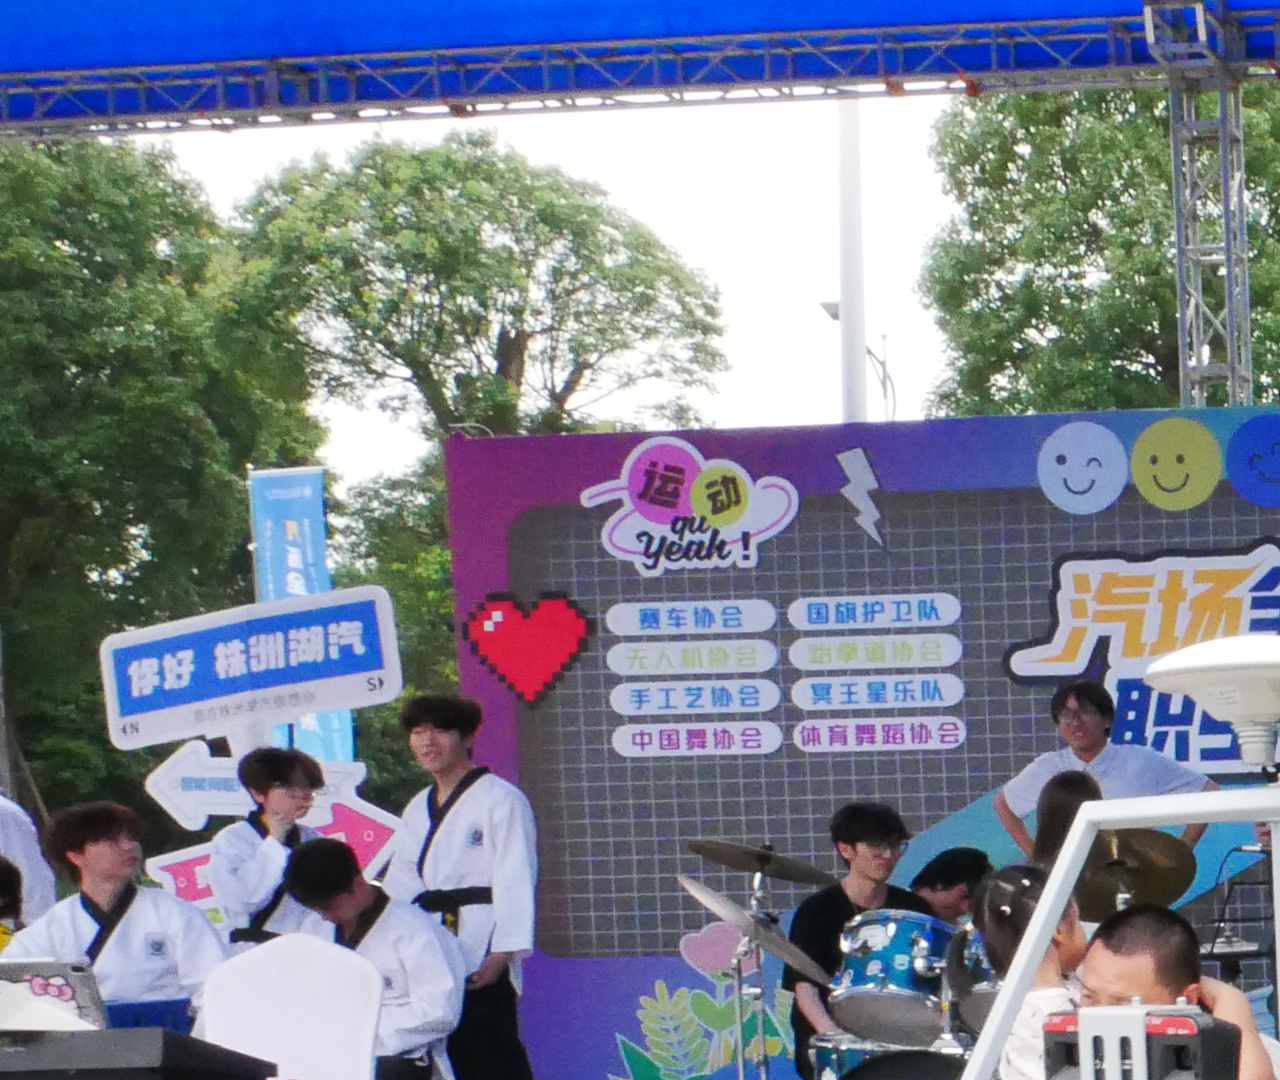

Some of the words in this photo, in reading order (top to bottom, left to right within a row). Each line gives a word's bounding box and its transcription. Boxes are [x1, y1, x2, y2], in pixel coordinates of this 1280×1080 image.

[637, 461, 742, 515] 运动
[639, 606, 742, 630] 赛车协会
[807, 599, 941, 624] 国旗护卫队
[128, 649, 194, 697] 你好
[214, 620, 366, 679] 株洲湖汽
[627, 646, 758, 670] 无人机协会
[367, 677, 378, 692] S
[811, 680, 945, 705] 冥王星乐队
[630, 685, 760, 710] 手工艺协会
[632, 728, 762, 751] 中国舞协会
[799, 722, 960, 747] 体育舞蹈协会
